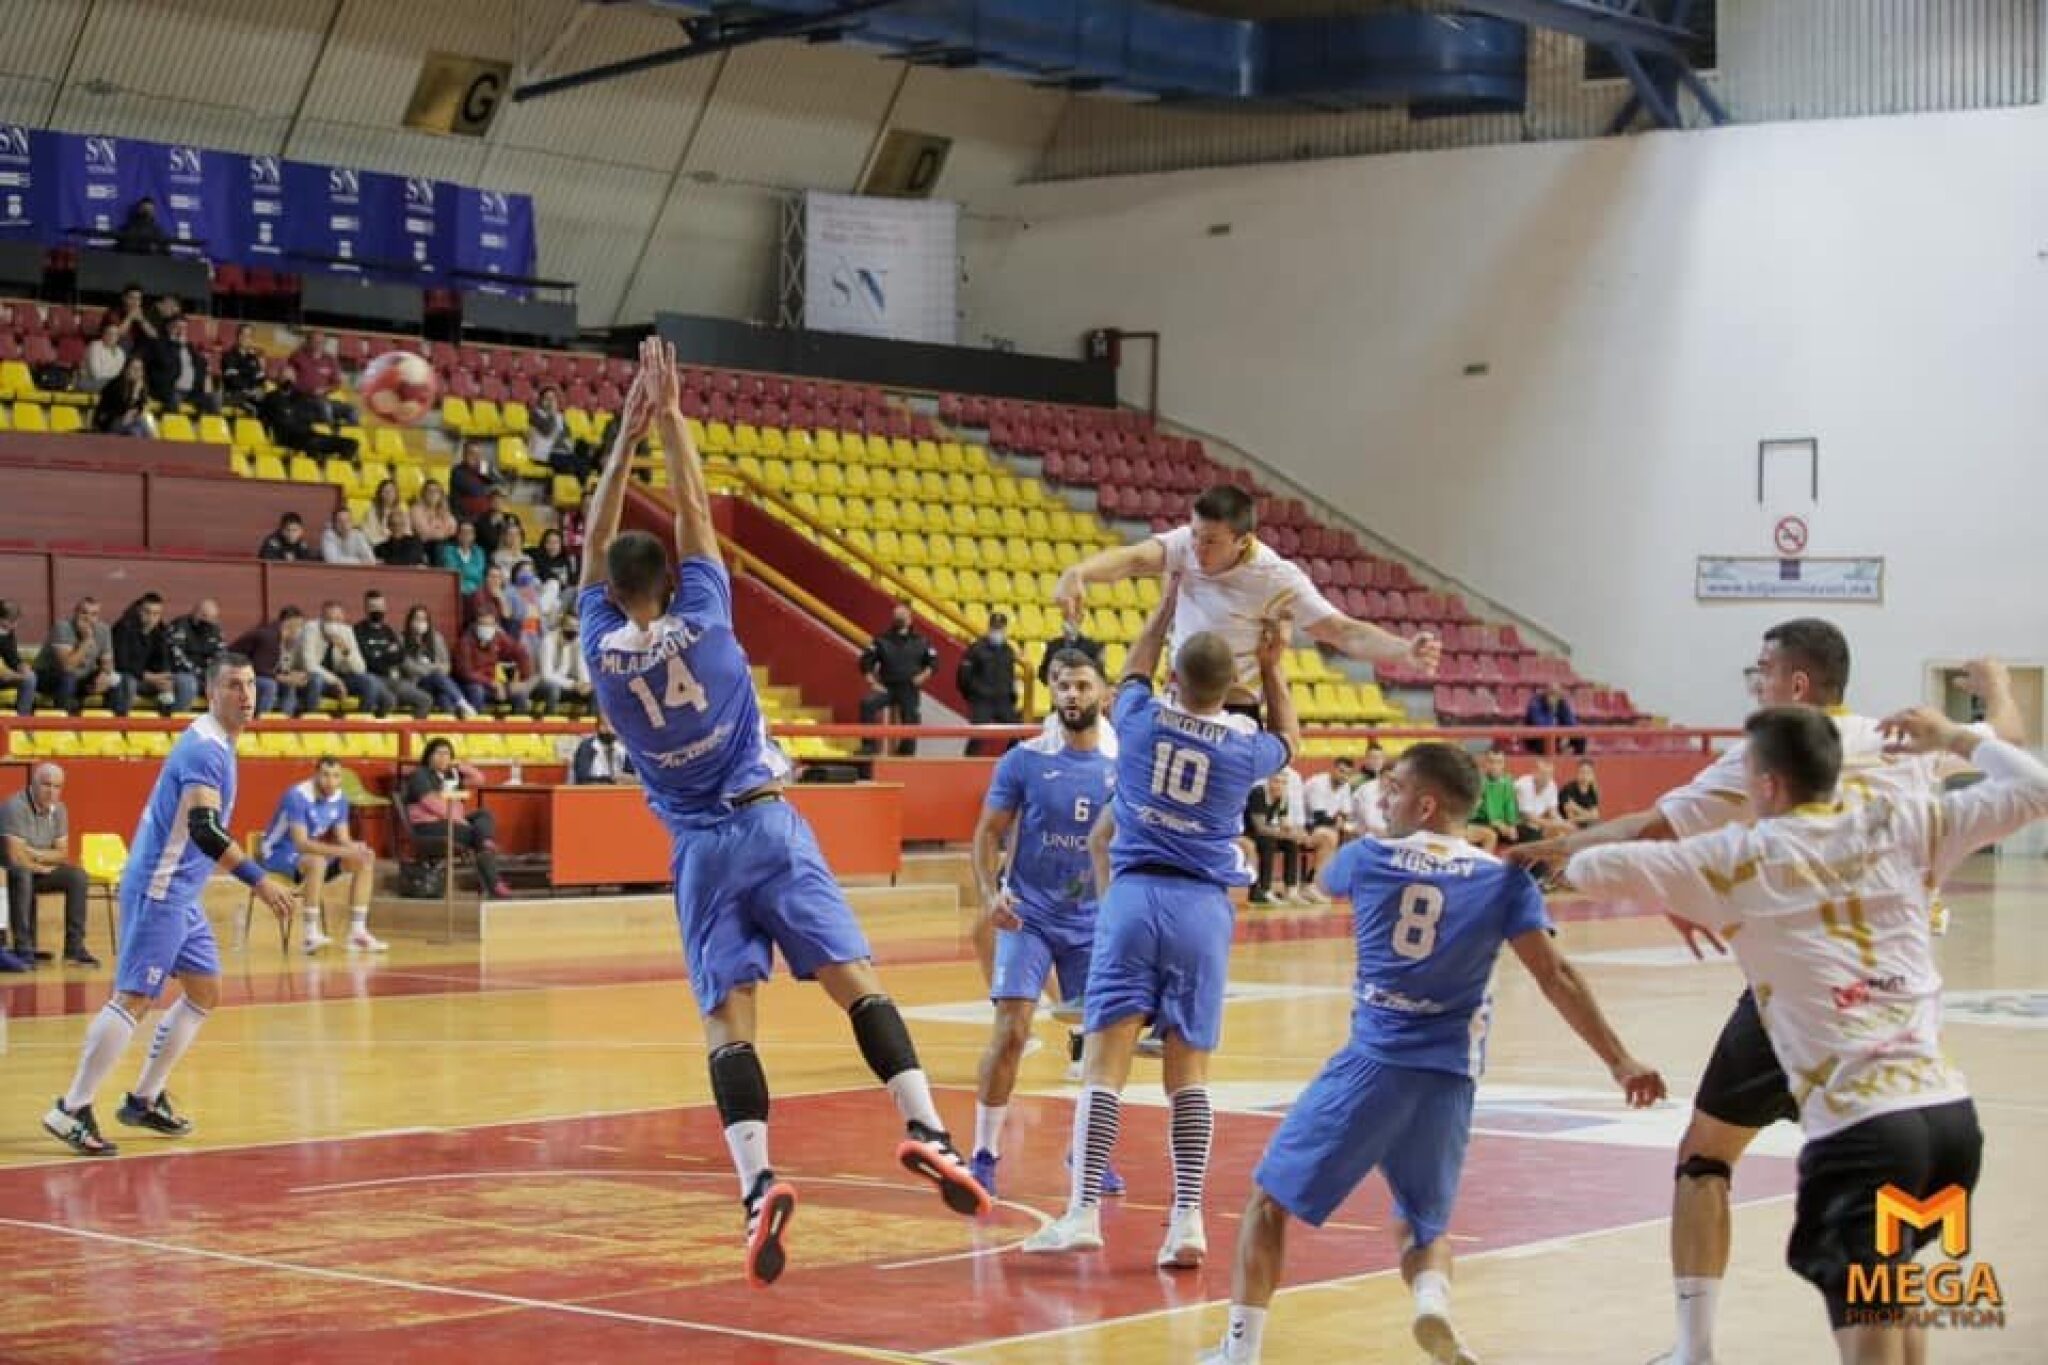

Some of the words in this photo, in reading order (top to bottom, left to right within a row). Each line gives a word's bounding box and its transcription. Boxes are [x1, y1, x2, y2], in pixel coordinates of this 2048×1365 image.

[463, 73, 498, 123] G
[628, 656, 709, 729] 14
[1151, 740, 1210, 805] 10
[1074, 797, 1090, 822] 6
[1392, 882, 1443, 960] 8
